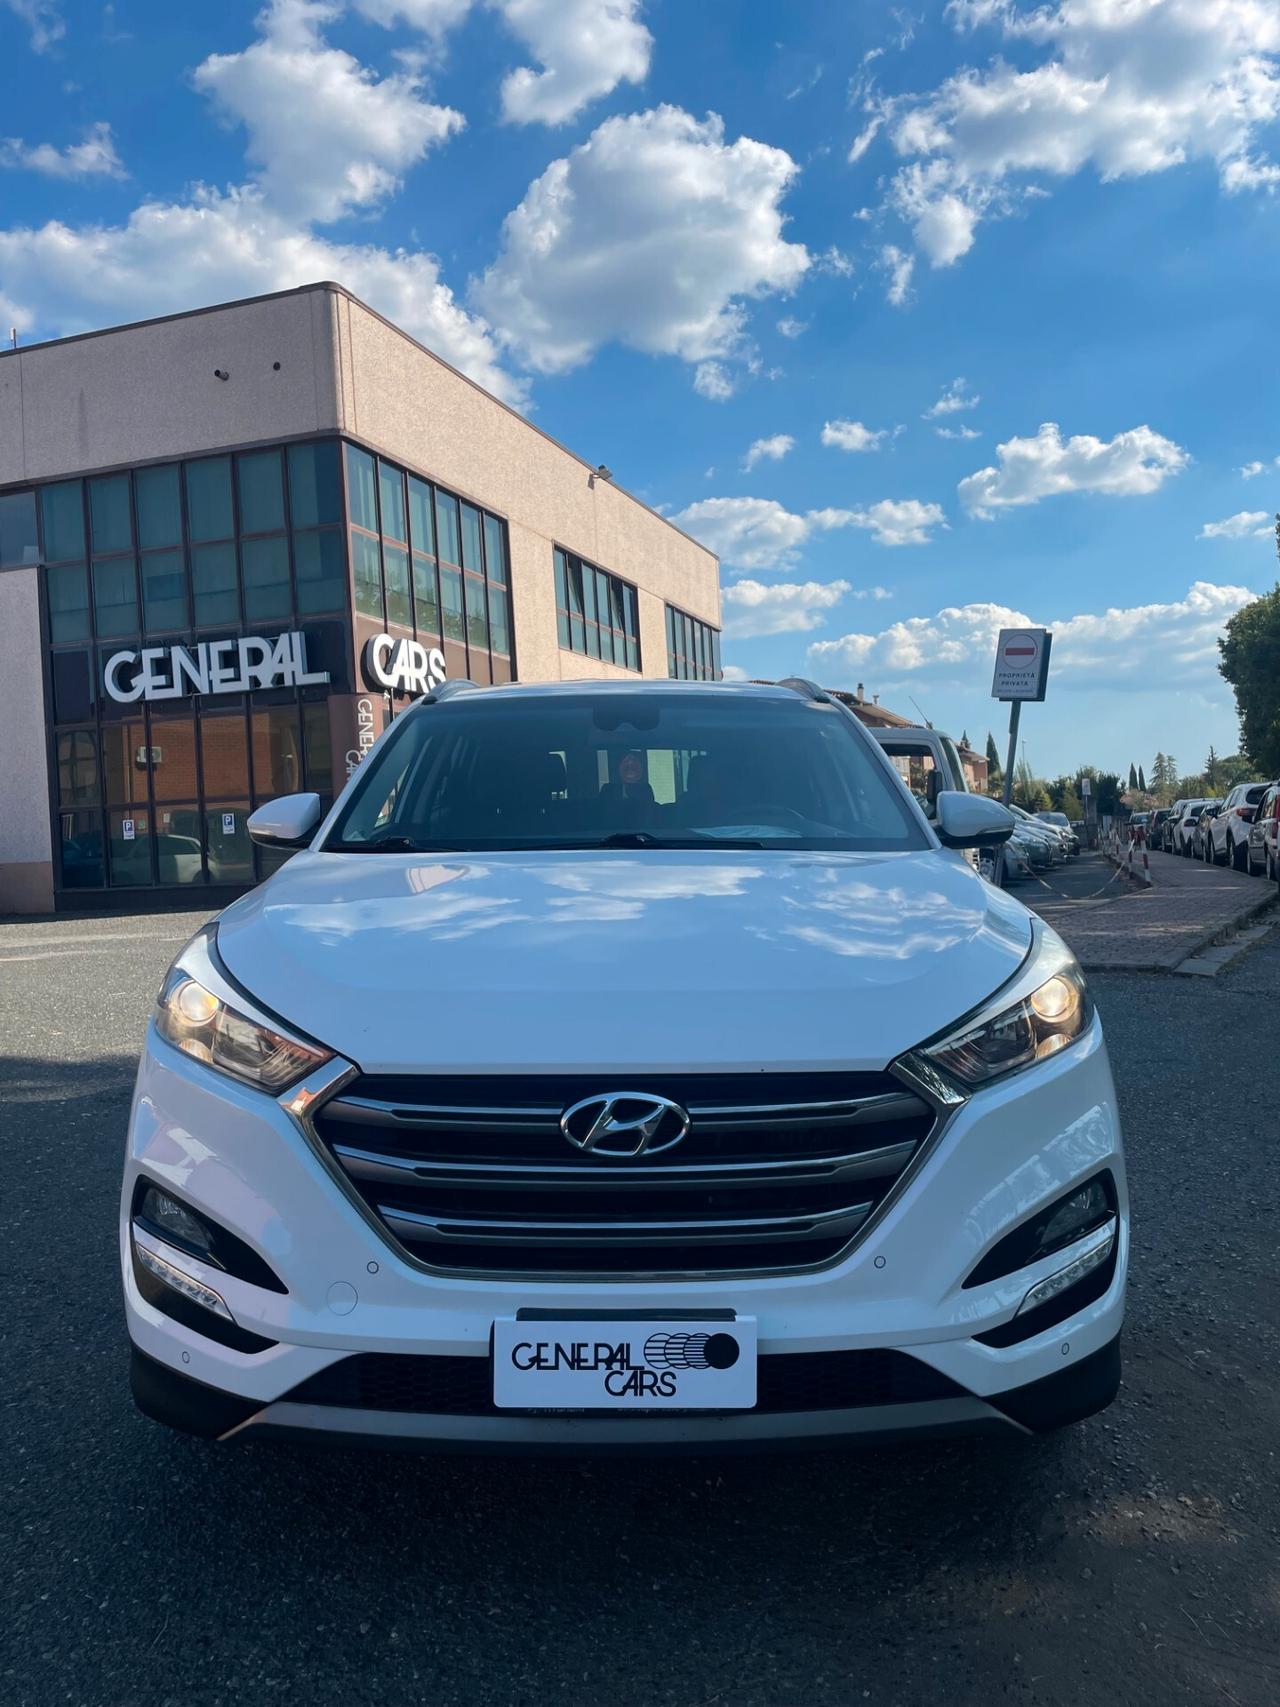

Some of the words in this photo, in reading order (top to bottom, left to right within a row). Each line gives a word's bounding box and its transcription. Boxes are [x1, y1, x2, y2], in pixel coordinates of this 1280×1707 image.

[104, 631, 330, 703] GENERAL
[368, 633, 446, 693] CARS
[511, 1342, 645, 1370] GENERAL
[604, 1370, 677, 1397] CARS
